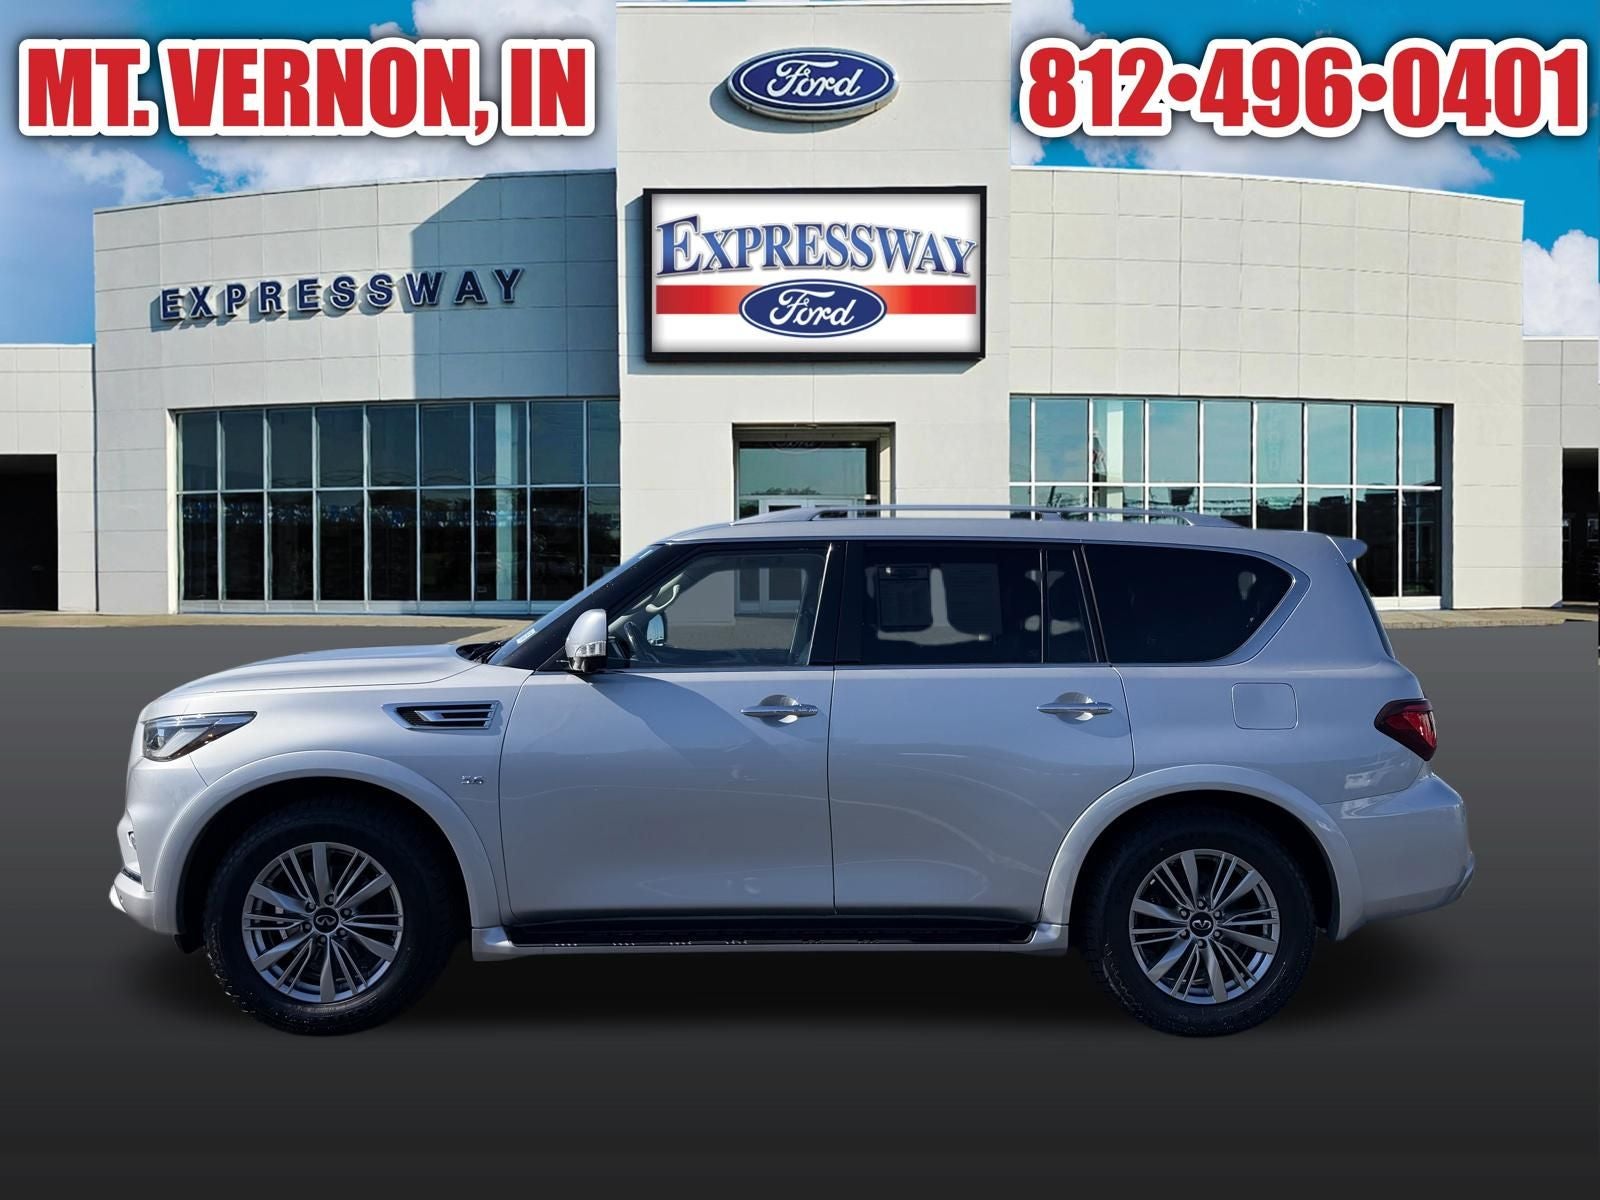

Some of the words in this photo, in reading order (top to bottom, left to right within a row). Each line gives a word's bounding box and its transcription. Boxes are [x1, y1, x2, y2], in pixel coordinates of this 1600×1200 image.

[766, 58, 863, 98] Ford
[656, 214, 978, 277] EXPRESSWAY
[160, 268, 525, 321] EXPRESSWAY
[769, 288, 857, 326] Ford
